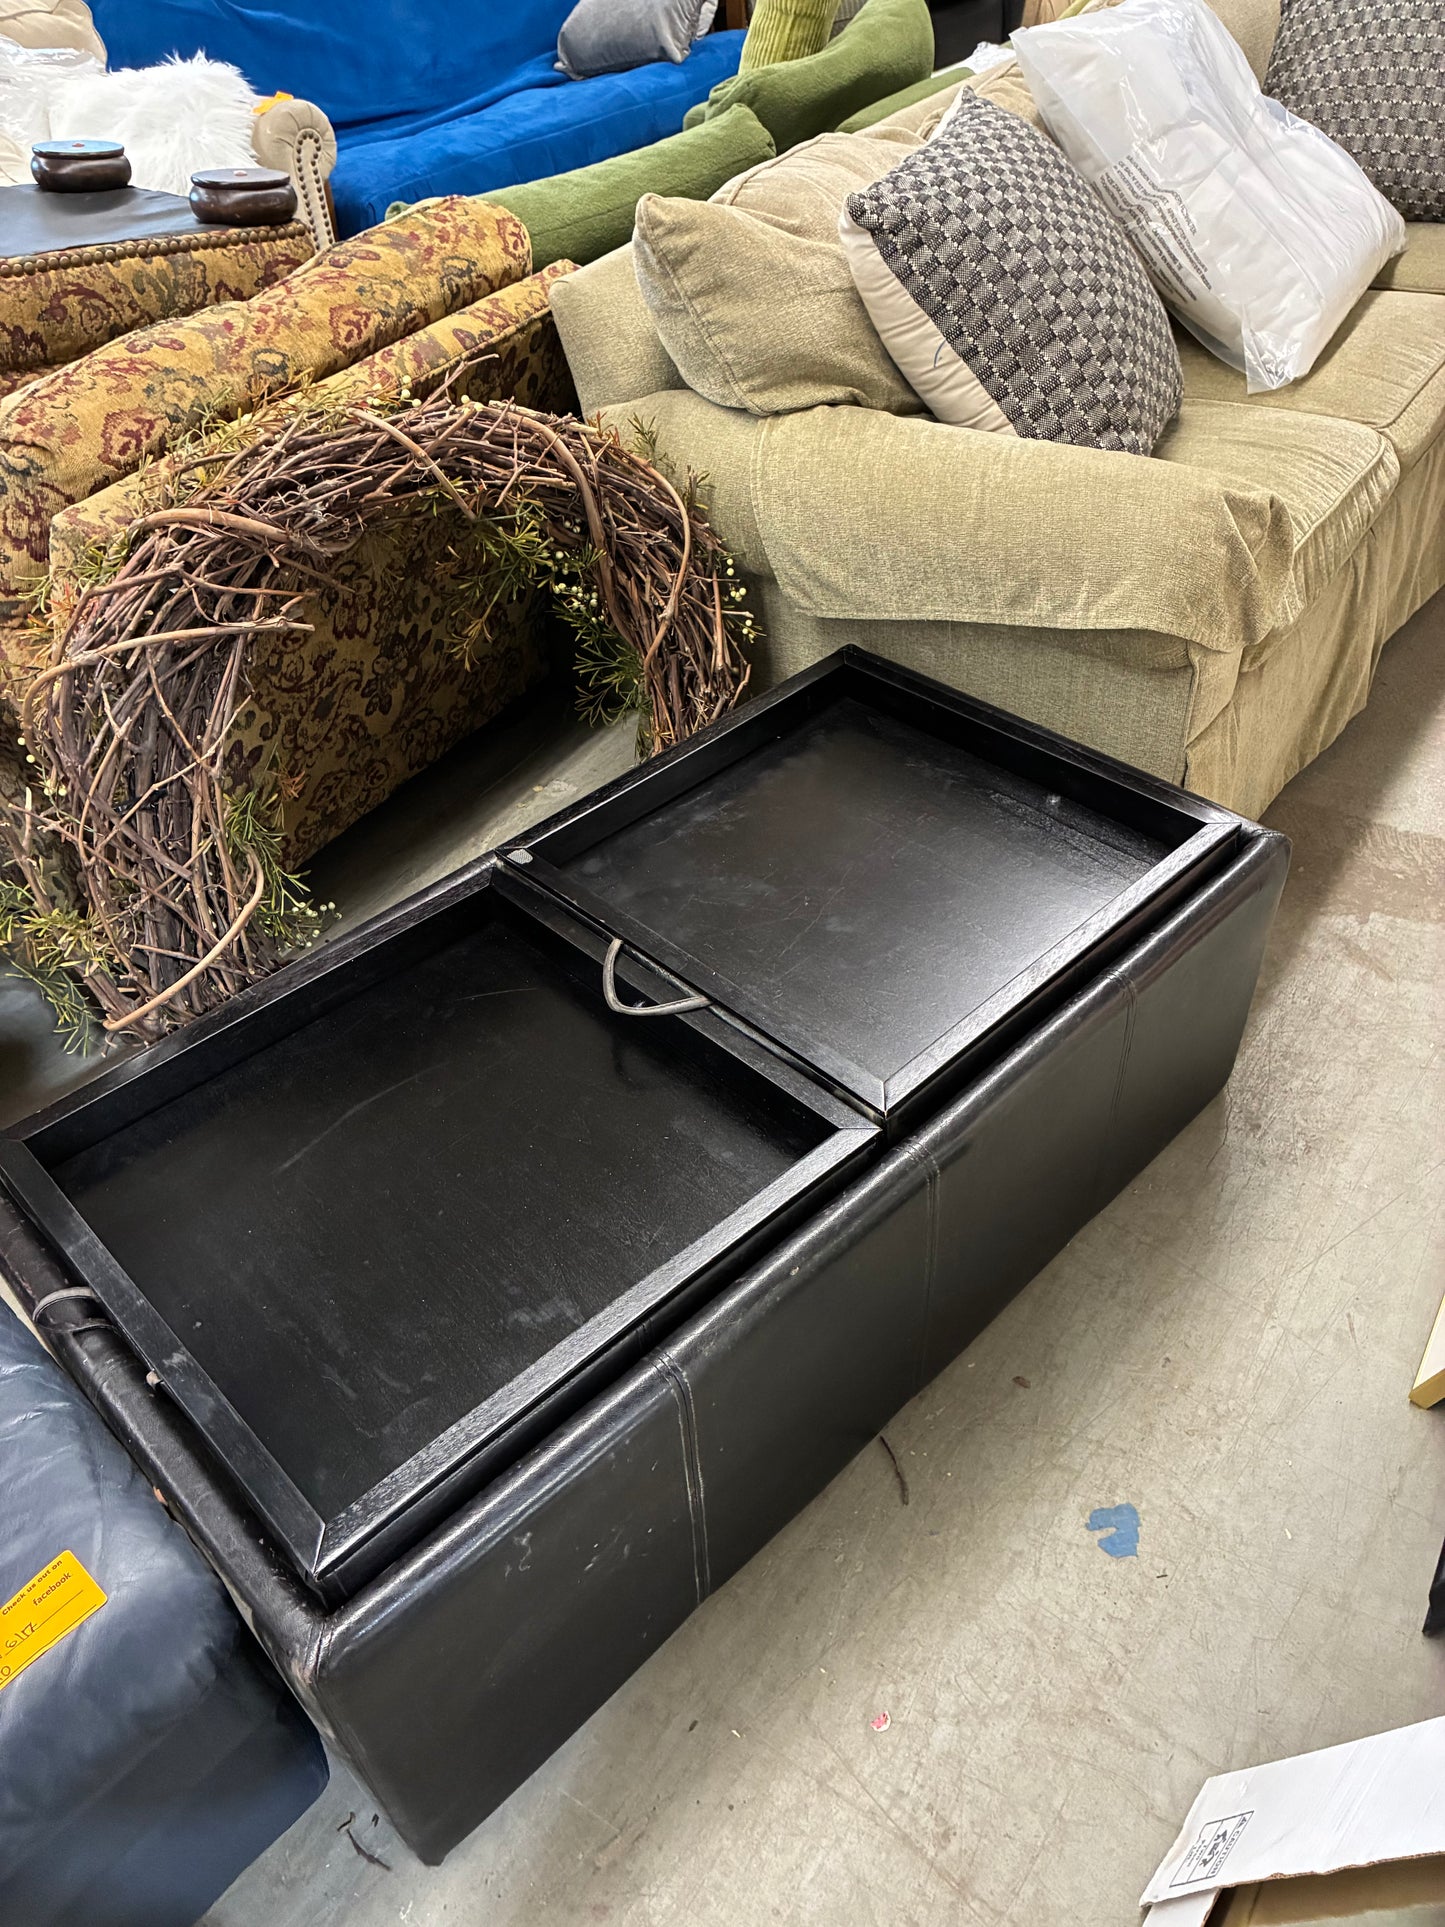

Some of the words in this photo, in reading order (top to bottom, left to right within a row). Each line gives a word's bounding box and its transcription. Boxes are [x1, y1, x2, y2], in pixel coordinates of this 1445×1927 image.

[2, 1592, 27, 1616] Check
[26, 1582, 37, 1593] us
[37, 1569, 51, 1583] out
[51, 1560, 63, 1570] on
[32, 1571, 72, 1606] facebook
